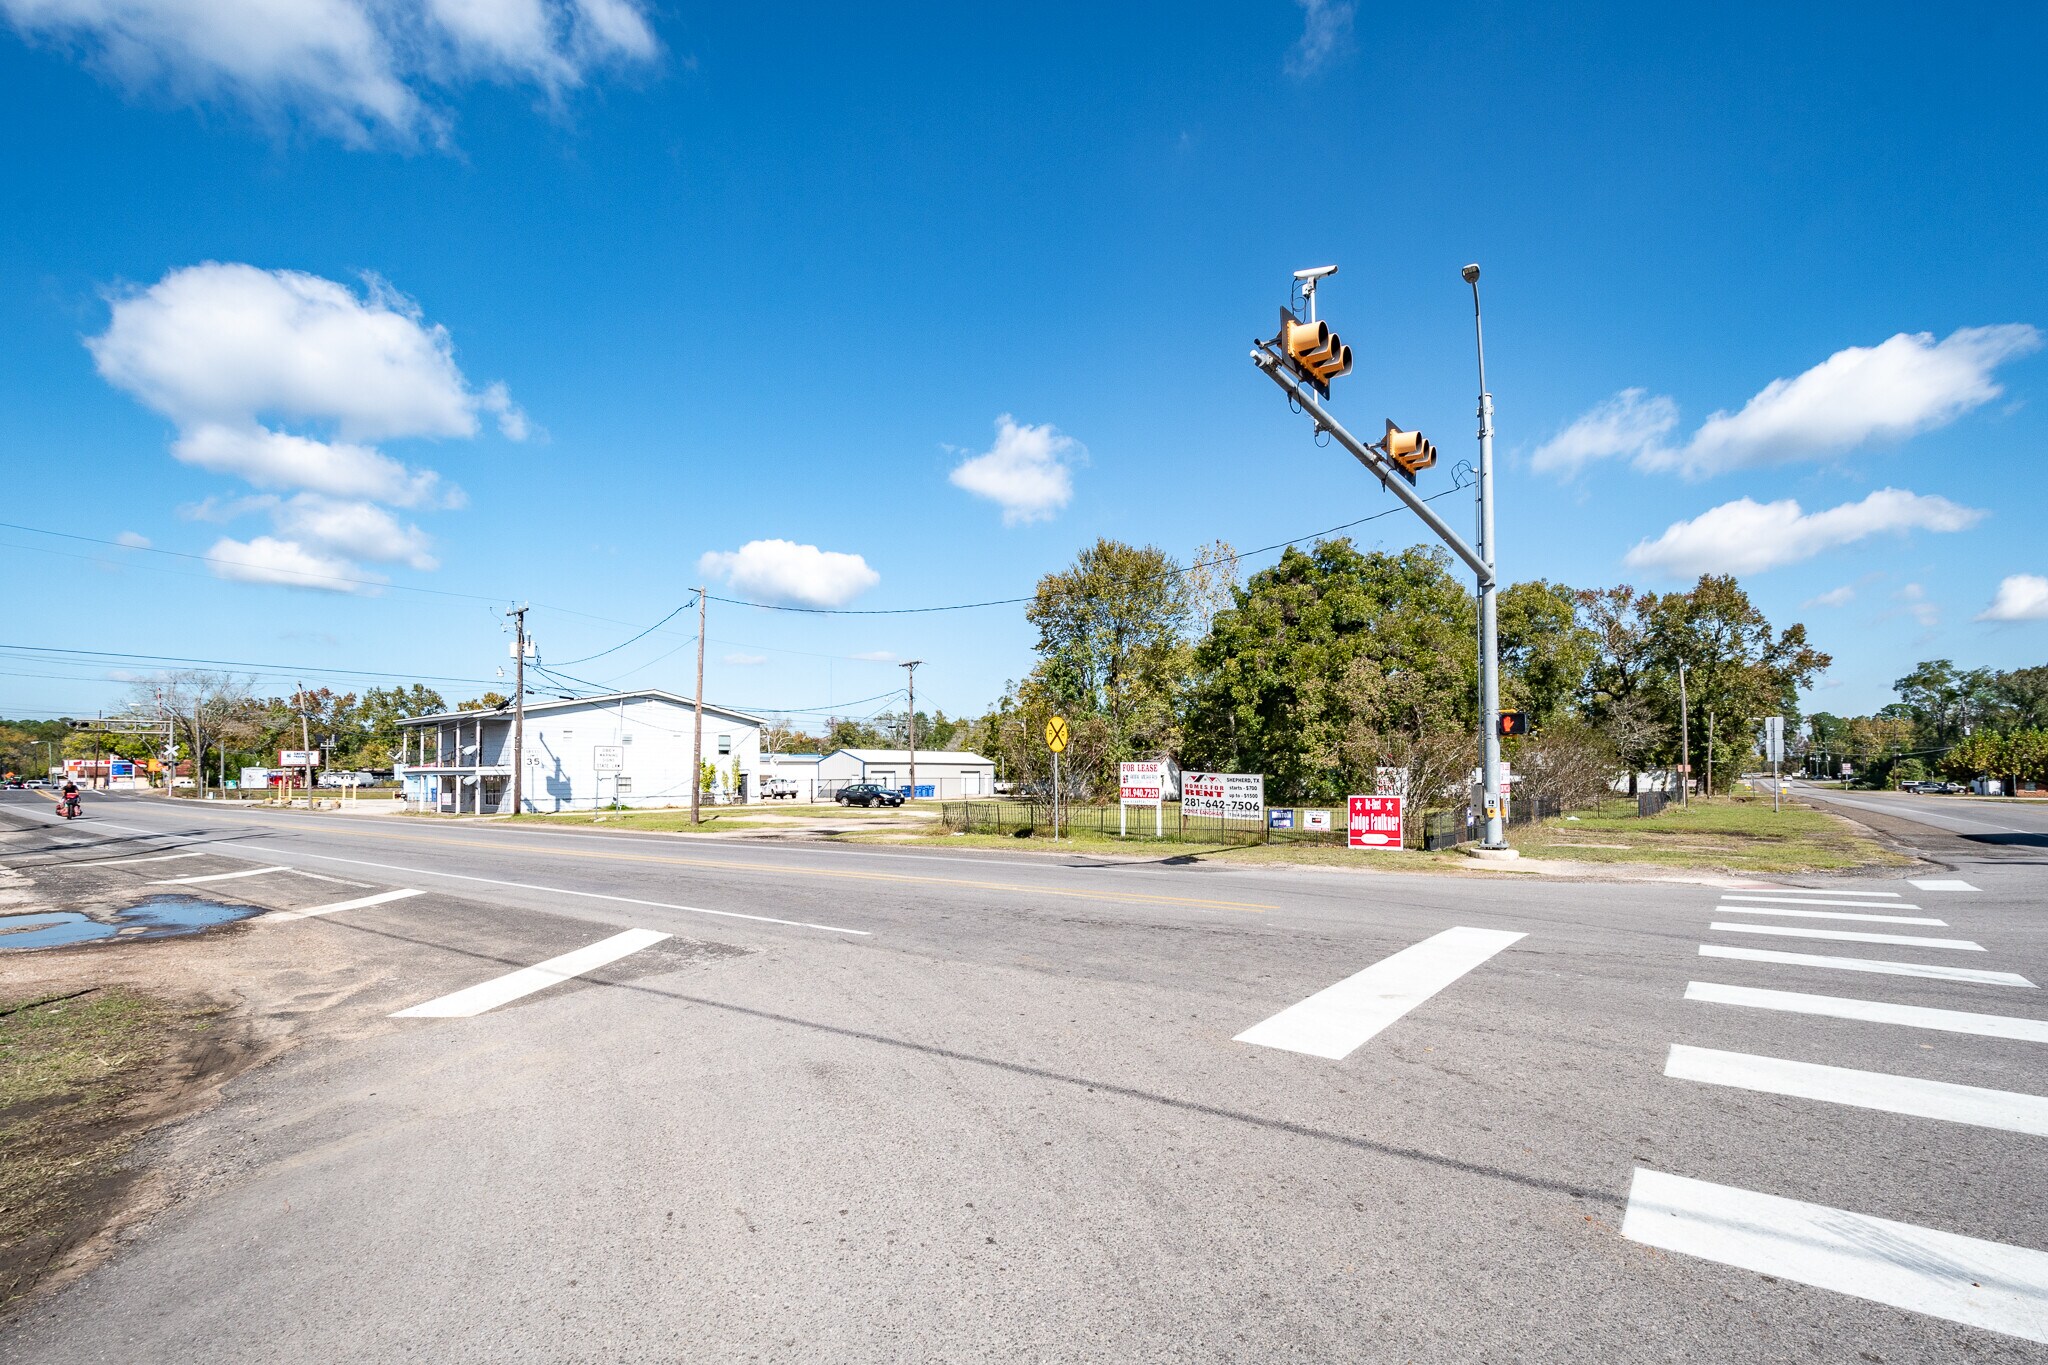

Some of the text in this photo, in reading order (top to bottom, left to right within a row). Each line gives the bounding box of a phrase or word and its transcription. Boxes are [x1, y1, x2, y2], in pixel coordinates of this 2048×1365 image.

[526, 757, 540, 766] 35
[1122, 764, 1158, 772] FOR LEASE
[1121, 788, 1159, 798] 281.940.7253
[1185, 789, 1224, 798] RENT
[1184, 798, 1260, 811] 281-642-7506
[1350, 813, 1370, 833] Judge
